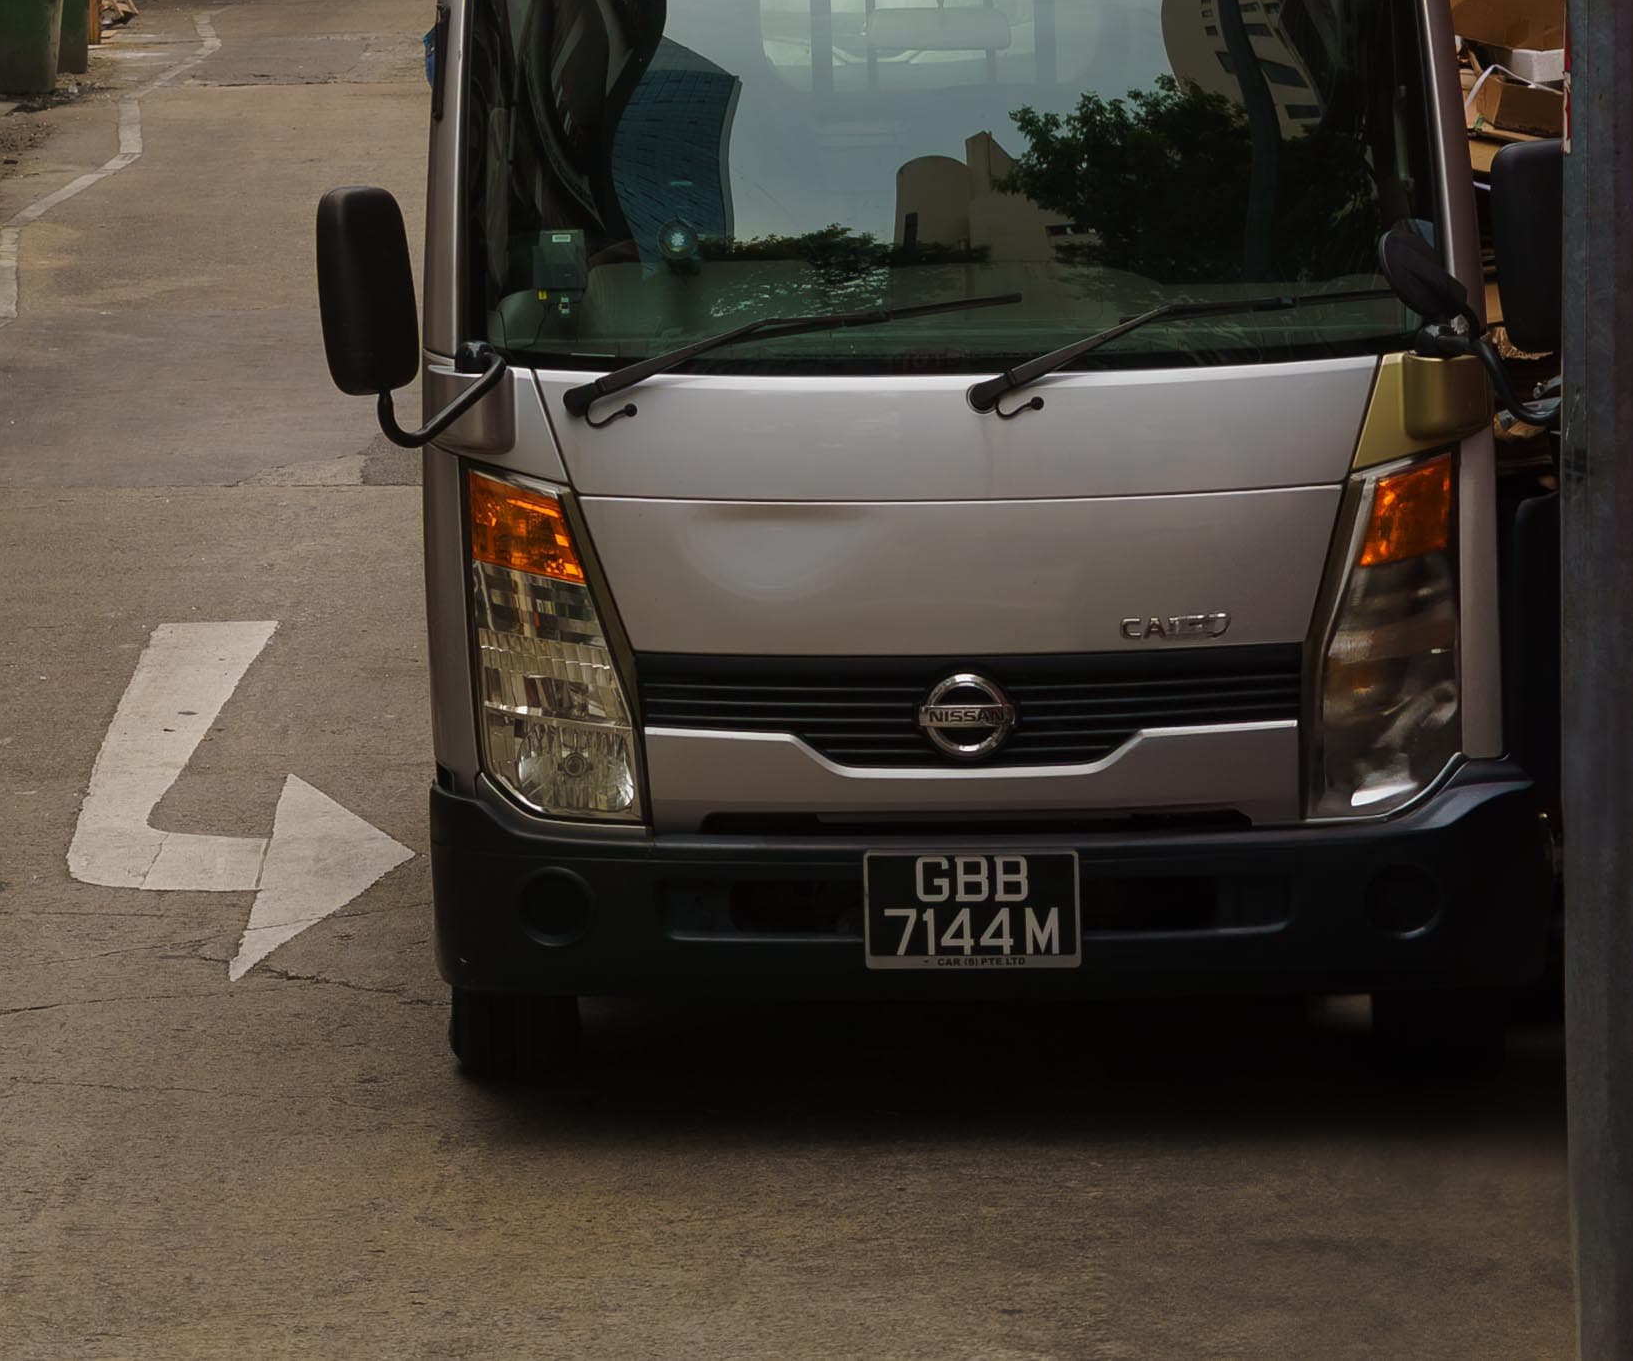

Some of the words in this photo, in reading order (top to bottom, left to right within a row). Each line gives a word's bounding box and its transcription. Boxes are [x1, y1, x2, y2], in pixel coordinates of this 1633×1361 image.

[929, 709, 1005, 724] NISSAN
[916, 855, 1029, 902] GBB
[937, 957, 960, 967] CAR
[980, 957, 1002, 967] PTE
[1006, 957, 1026, 967] LTD
